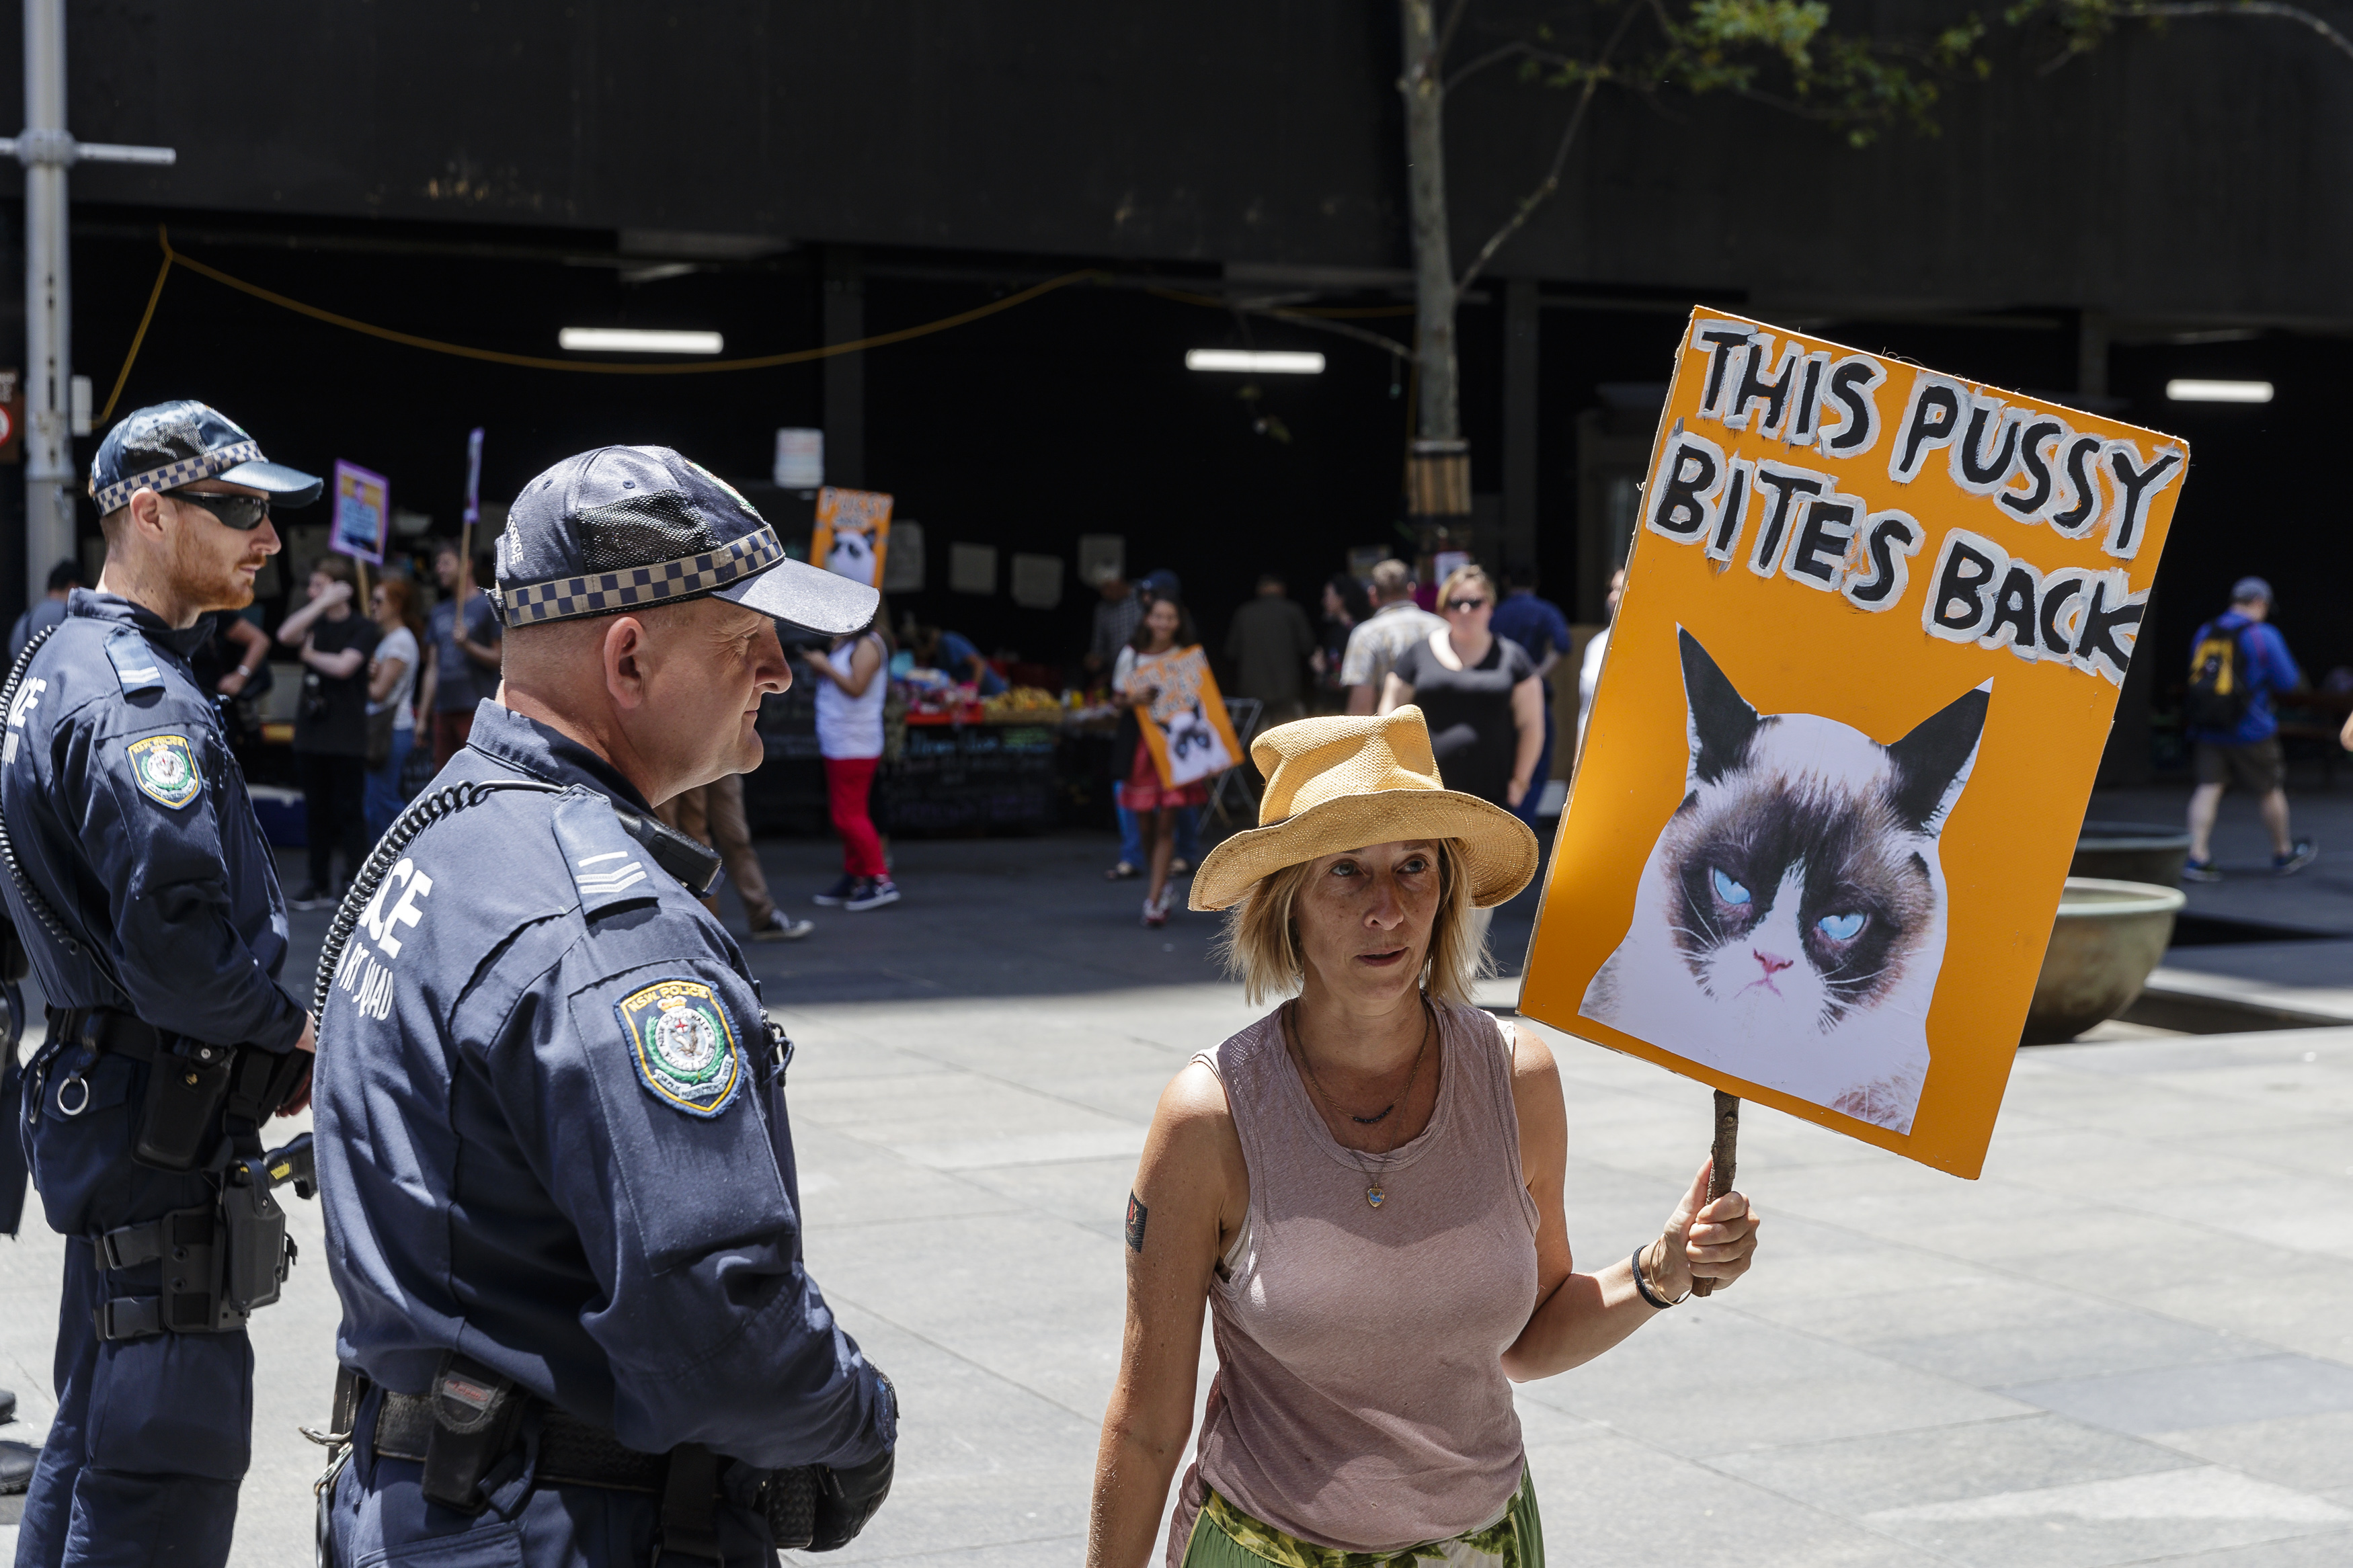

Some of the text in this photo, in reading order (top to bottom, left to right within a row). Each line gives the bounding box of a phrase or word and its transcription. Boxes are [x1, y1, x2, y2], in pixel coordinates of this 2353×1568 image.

[1646, 427, 2151, 687] BITES BACK
[1691, 319, 2185, 559] THIS PUSSY
[627, 985, 709, 1012] NSW POLICE
